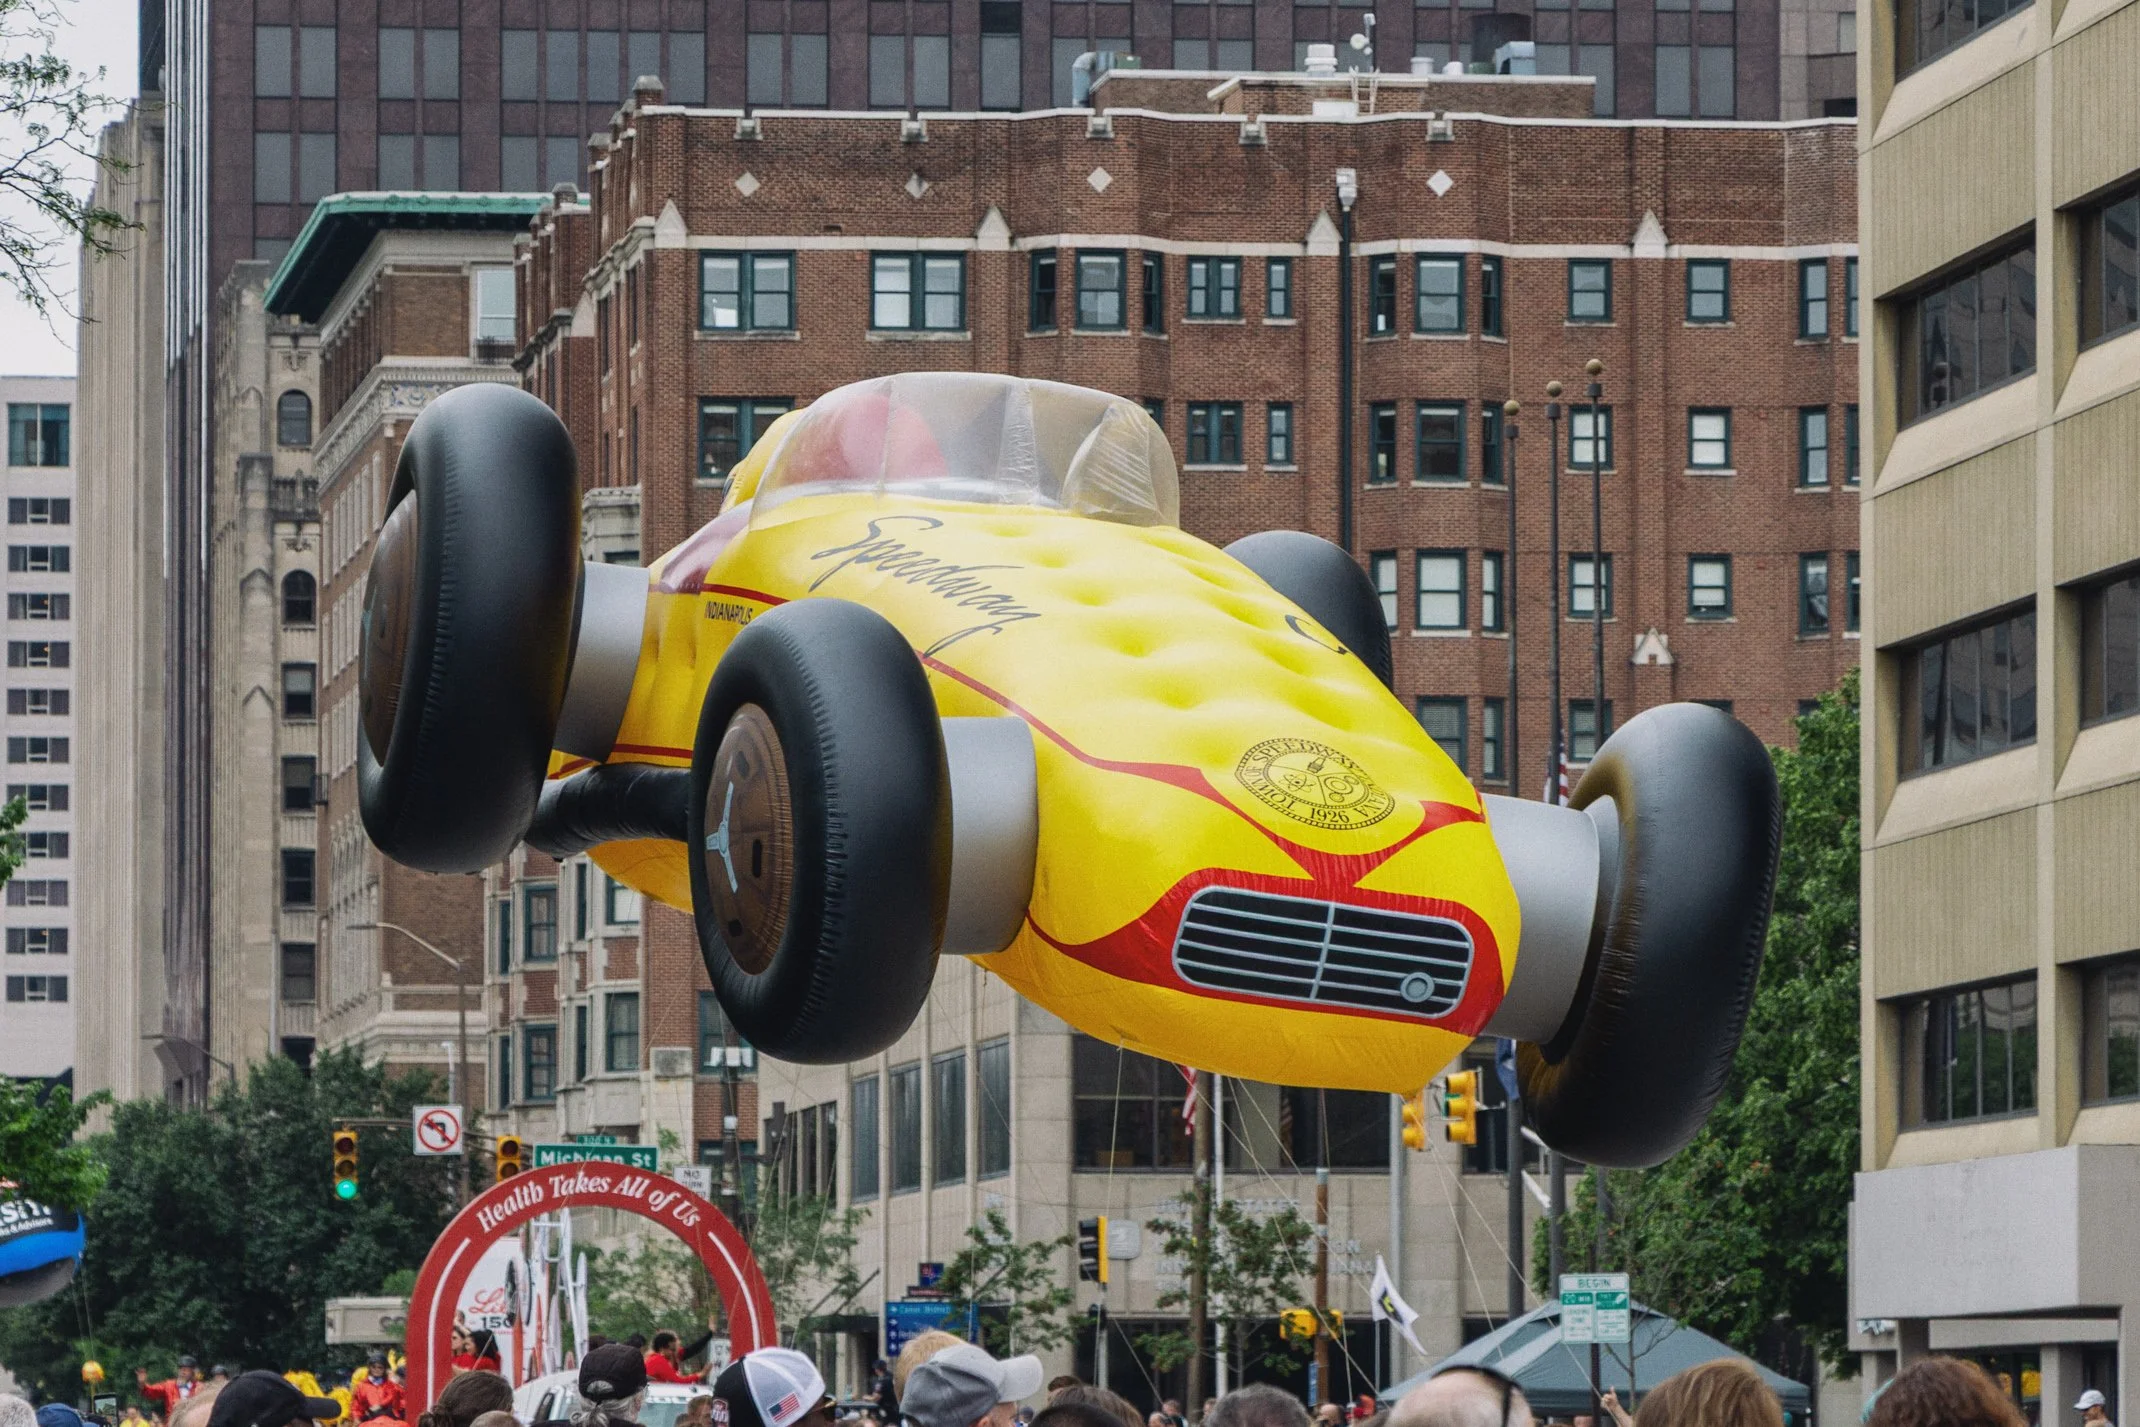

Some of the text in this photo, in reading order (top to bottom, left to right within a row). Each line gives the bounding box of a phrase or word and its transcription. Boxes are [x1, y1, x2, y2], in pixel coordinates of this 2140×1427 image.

[808, 516, 1042, 658] Speedway
[1244, 766, 1263, 777] OF
[1251, 778, 1298, 812] TOWN
[1310, 807, 1350, 824] 1926
[631, 1152, 652, 1167] St
[476, 1171, 701, 1233] Health Takes All of Us
[1578, 1278, 1611, 1289] BEGIN
